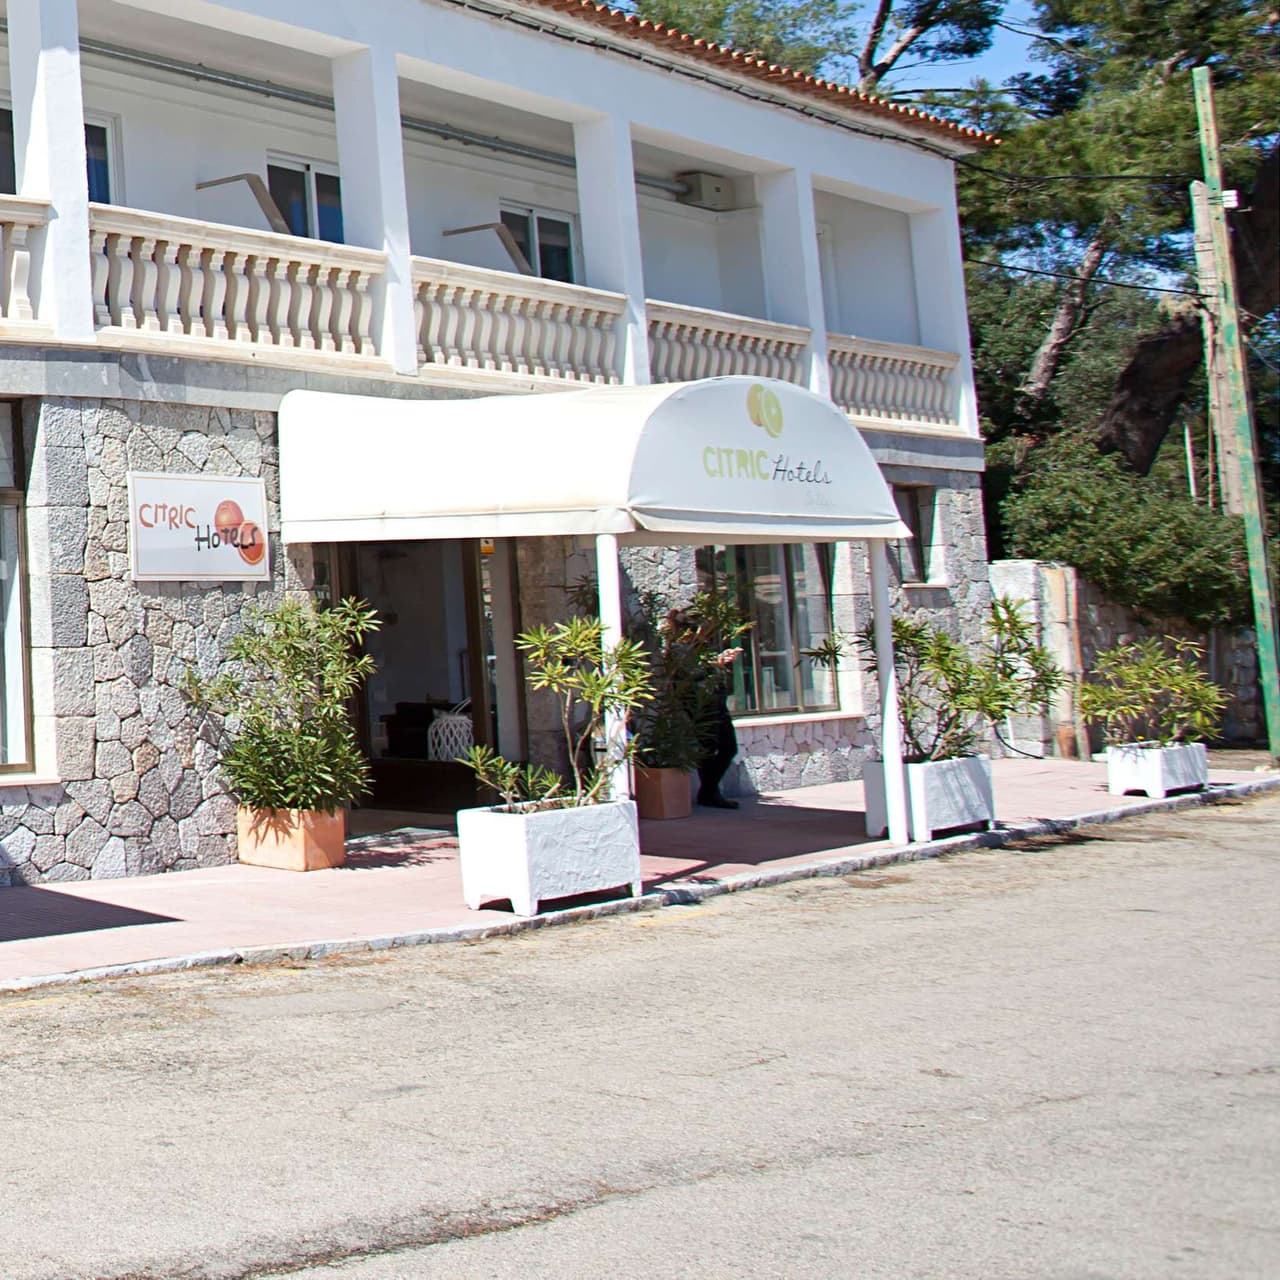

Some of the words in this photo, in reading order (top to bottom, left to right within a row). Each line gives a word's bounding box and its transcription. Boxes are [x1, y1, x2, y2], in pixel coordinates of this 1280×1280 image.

[702, 446, 770, 480] CITRIC
[772, 454, 832, 484] Hotels
[138, 503, 196, 530] CITRIC
